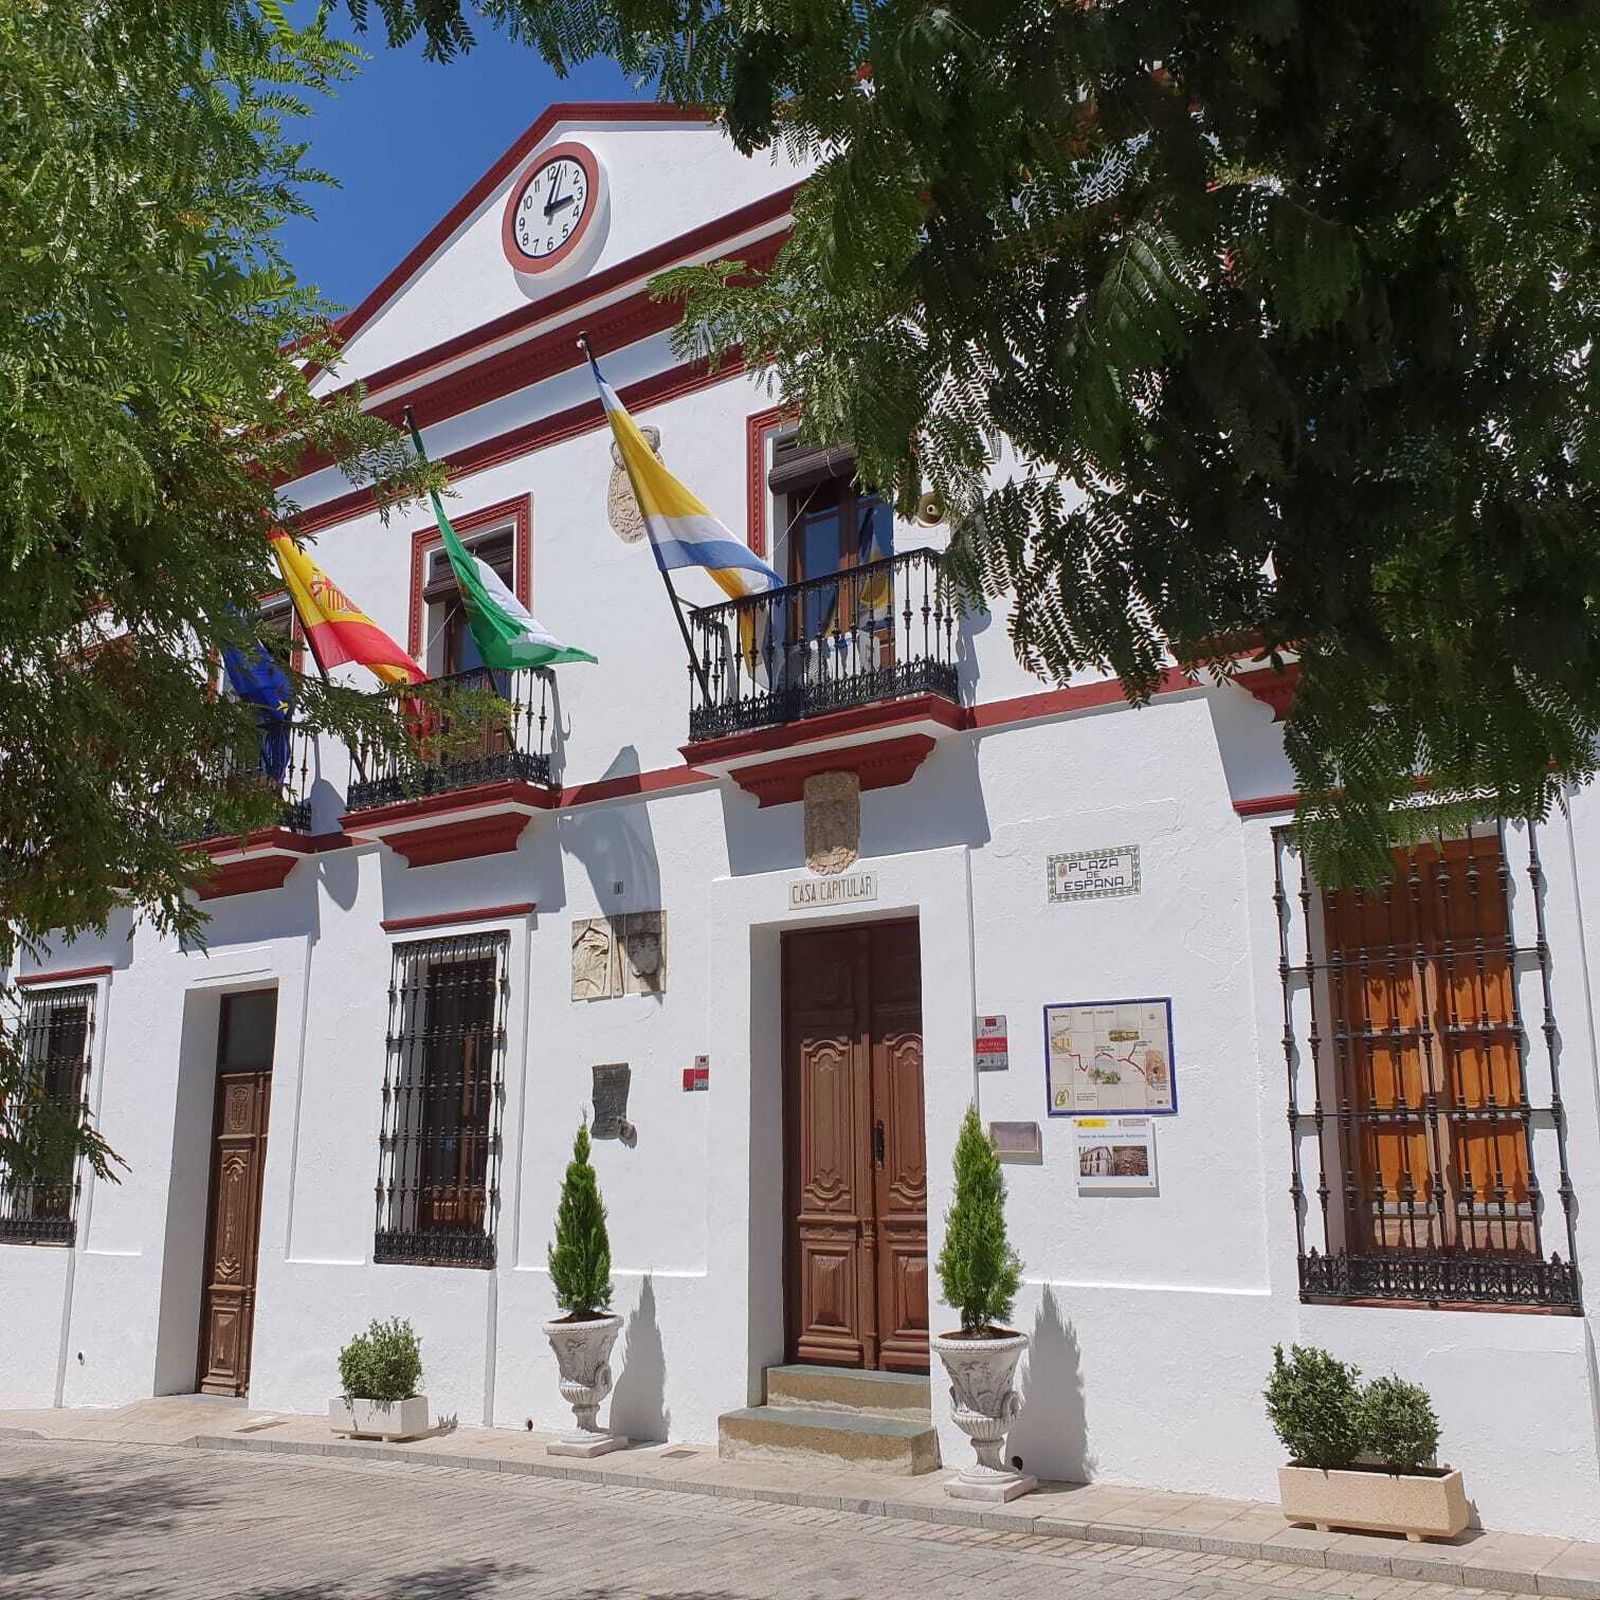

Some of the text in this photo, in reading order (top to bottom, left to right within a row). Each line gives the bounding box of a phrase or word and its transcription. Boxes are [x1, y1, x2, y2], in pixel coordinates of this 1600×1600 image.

[547, 166, 557, 182] 12
[573, 169, 580, 185] 2
[534, 179, 541, 193] 11
[576, 186, 583, 201] 3
[523, 195, 533, 212] 10
[572, 205, 579, 219] 4
[518, 217, 526, 232] 9
[562, 223, 569, 239] 5
[522, 232, 529, 247] 8
[533, 238, 540, 253] 7
[546, 237, 554, 251] 6
[1068, 858, 1119, 872] PLAZA
[1086, 870, 1100, 879] DE
[792, 876, 872, 904] CASA CAPITULAR
[1064, 875, 1124, 891] ESPAÑA
